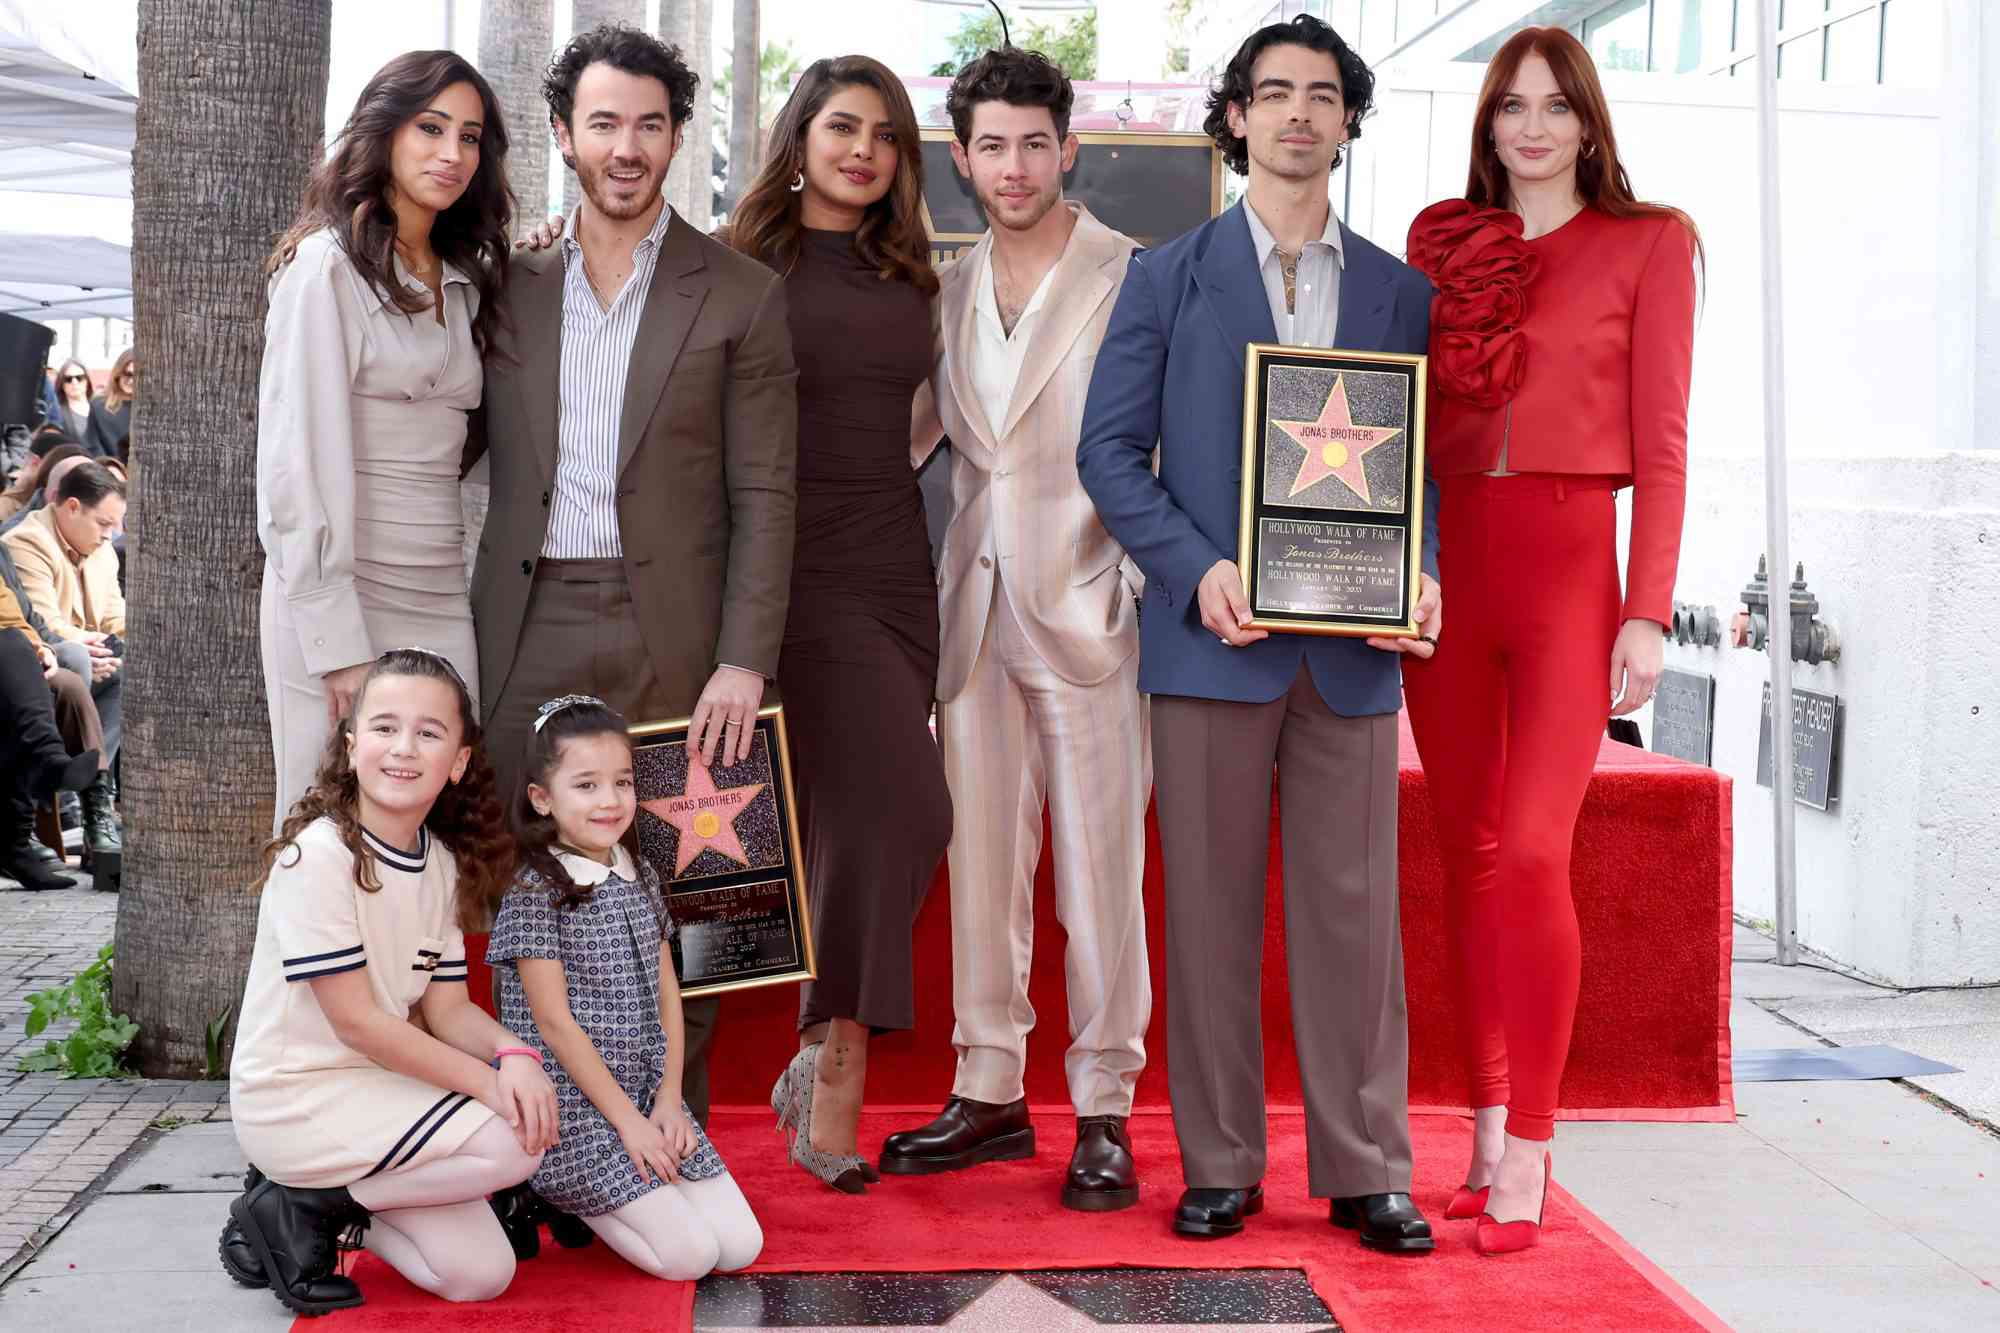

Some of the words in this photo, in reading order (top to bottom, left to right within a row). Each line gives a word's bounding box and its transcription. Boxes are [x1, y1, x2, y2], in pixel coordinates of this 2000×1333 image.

[1300, 427, 1327, 438] JONAS
[1331, 427, 1374, 441] BROTHERS
[1268, 522, 1321, 536] HOLLYWOOD
[1326, 525, 1351, 537] WALK
[1356, 527, 1368, 539] OF
[1372, 528, 1396, 541] FAME
[1280, 544, 1322, 559] Jonas
[1326, 547, 1384, 562] Brothers
[1266, 568, 1321, 582] HOLLYWOOD
[1325, 574, 1351, 584] WALK
[1355, 575, 1367, 585] OF
[1371, 576, 1394, 586] FAME
[1805, 698, 1833, 734] HEADER
[669, 800, 695, 813] JONAS
[698, 792, 743, 809] BROTHERS
[709, 889, 737, 903] WALK
[740, 886, 751, 899] OF
[755, 882, 781, 897] FAME
